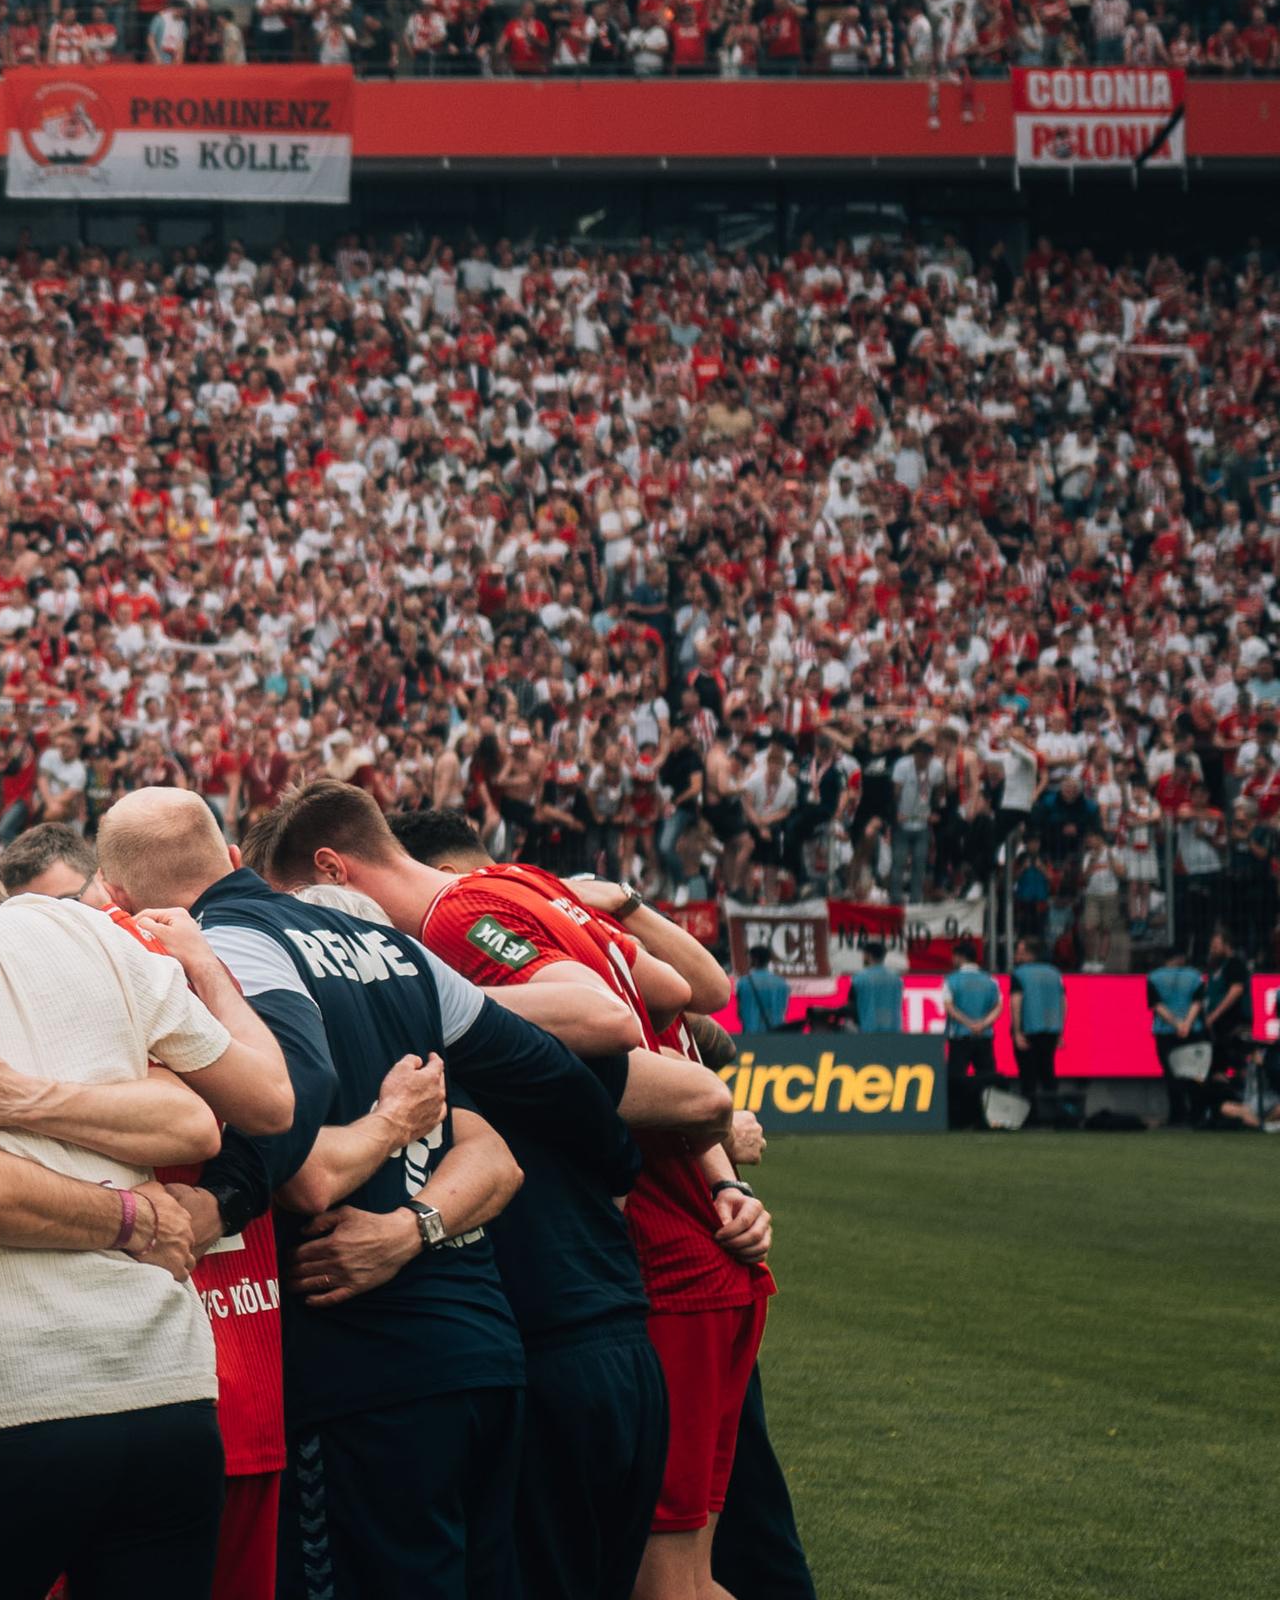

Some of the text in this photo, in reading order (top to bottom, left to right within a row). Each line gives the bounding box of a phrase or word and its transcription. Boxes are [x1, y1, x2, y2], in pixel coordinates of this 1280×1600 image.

[1027, 70, 1172, 110] COLONIA
[130, 97, 331, 129] PROMINENZ
[143, 134, 311, 172] US KÖLLE
[285, 928, 419, 985] REWE
[475, 923, 530, 961] DEVK
[229, 1277, 280, 1316] KÖLN
